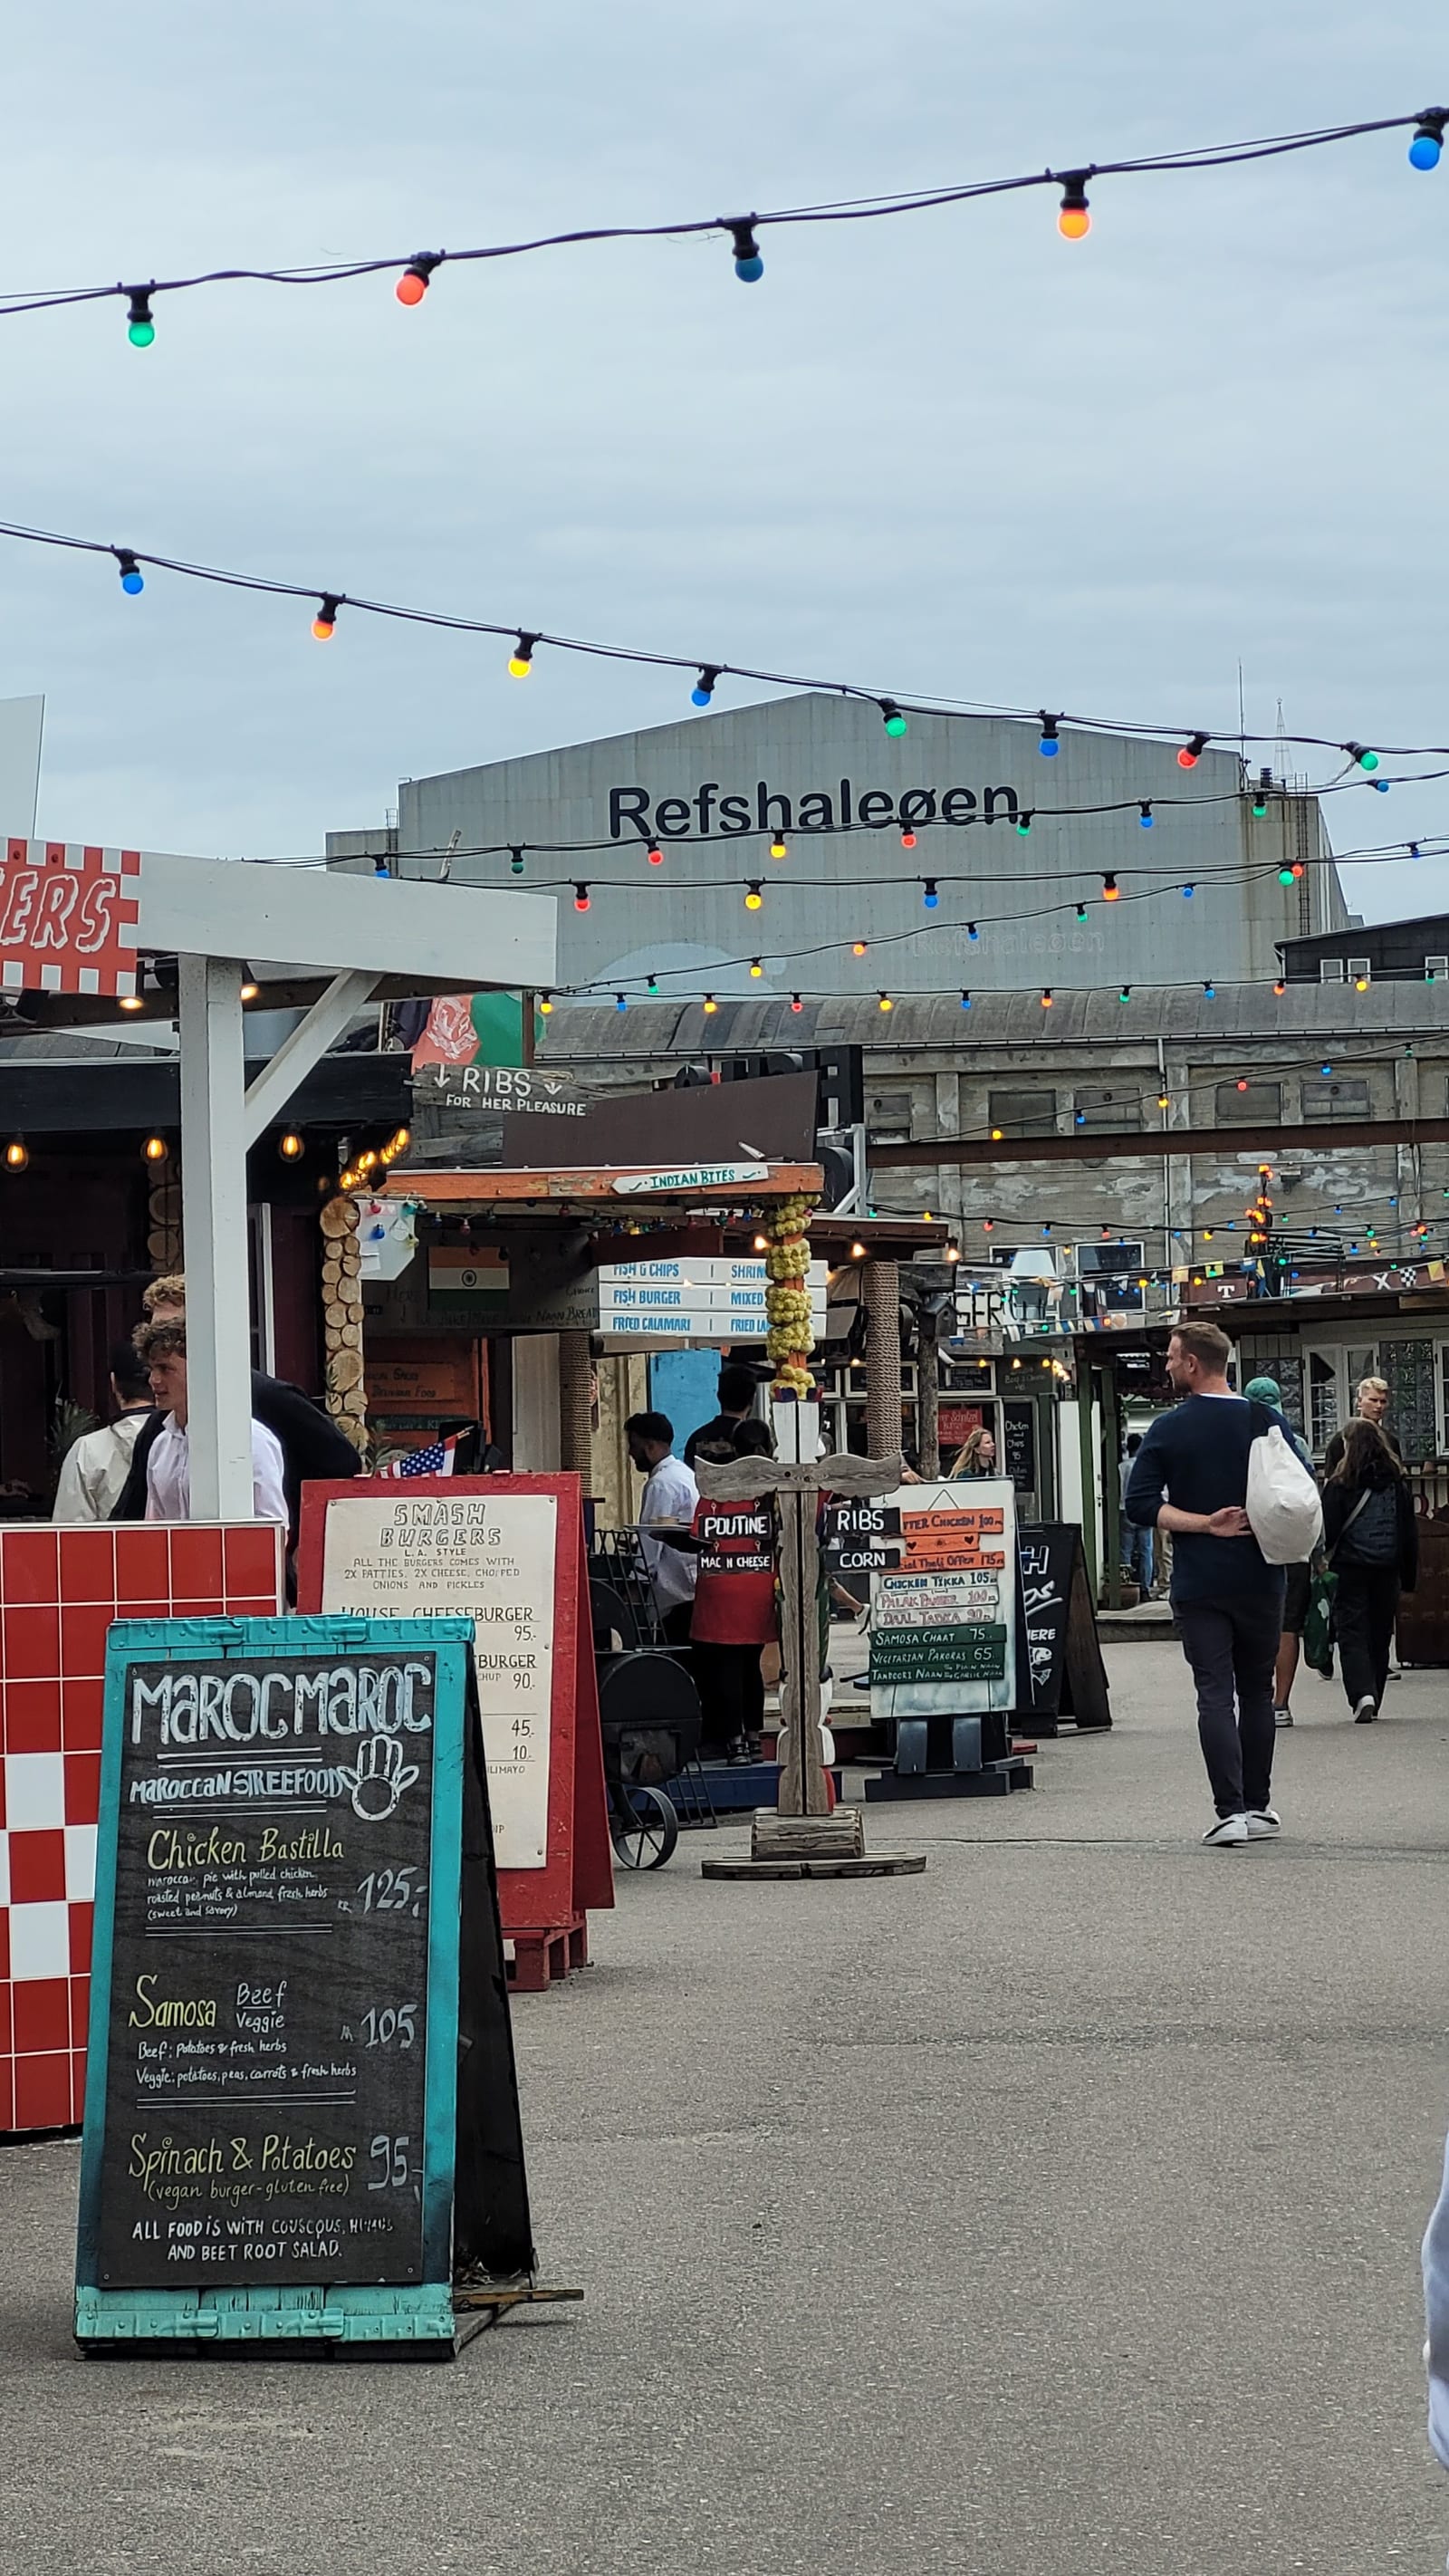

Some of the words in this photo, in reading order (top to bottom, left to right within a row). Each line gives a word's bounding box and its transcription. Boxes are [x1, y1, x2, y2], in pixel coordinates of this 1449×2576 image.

[610, 778, 1019, 839] Refshaleøen
[0, 867, 117, 953] ERS
[463, 1067, 532, 1097] RIBS
[446, 1094, 471, 1108] FOR
[483, 1098, 513, 1110] HER
[517, 1099, 586, 1116] PLEASURE
[649, 1173, 697, 1188] INDIAN
[700, 1169, 735, 1184] BITES
[648, 1263, 679, 1277] CHIPS
[613, 1290, 635, 1304] FISH
[638, 1291, 681, 1305] BURGER
[731, 1292, 763, 1305] MIXED
[612, 1316, 638, 1331] FRIED
[642, 1317, 690, 1331] CALAMARI
[731, 1319, 754, 1332] FRIED
[394, 1504, 485, 1525] SMASH
[838, 1510, 884, 1531] RIBS
[705, 1516, 767, 1537] POUTINE
[380, 1528, 501, 1547] BURGERS
[437, 1548, 466, 1556] STYLE
[700, 1556, 722, 1568] MAC
[726, 1558, 734, 1568] N
[736, 1555, 770, 1568] CHEESE
[840, 1552, 886, 1568] CORN
[353, 1558, 373, 1567] ALL
[379, 1558, 398, 1567] THE
[404, 1559, 443, 1567] BURGERS
[449, 1558, 479, 1566] COMES
[486, 1557, 514, 1565] WITH
[344, 1570, 357, 1579] 2X
[415, 1569, 427, 1578] 2X
[883, 1577, 927, 1590] CHICKEN
[931, 1574, 965, 1587] TIKKA
[970, 1572, 989, 1584] 105
[372, 1581, 408, 1590] ONIONS
[418, 1581, 438, 1589] AND
[446, 1581, 485, 1589] PICKLES
[880, 1594, 918, 1608] PALAK
[413, 1607, 533, 1621] CHEESEBURGER
[875, 1631, 919, 1646] SAMOSA
[923, 1631, 955, 1642] CHAAT
[474, 1654, 537, 1668] BURGER
[927, 1648, 966, 1661] PAKORAS
[916, 1668, 942, 1678] NAAN
[148, 1826, 246, 1870] Chicken
[256, 1828, 345, 1862] Bastilla
[202, 1872, 218, 1888] pie
[222, 1869, 247, 1880] with
[249, 1867, 276, 1886] pulled
[280, 1866, 315, 1879] chicken
[147, 1889, 179, 1904] roasted
[185, 1888, 223, 1905] peanuts
[226, 1888, 234, 1898] &
[305, 1885, 328, 1898] herbs
[148, 1908, 182, 1921] (sweet
[185, 1905, 202, 1918] and
[205, 1904, 238, 1918] savory)
[129, 1974, 216, 2028] Samosa
[236, 1980, 288, 2008] Beef
[235, 2011, 286, 2033] Veggie
[360, 2004, 417, 2049] 105
[138, 2041, 173, 2062] Beef:
[229, 2039, 254, 2057] fresh
[259, 2039, 288, 2052] herbs
[136, 2067, 176, 2090] Veggie:
[250, 2063, 287, 2080] carrots
[301, 2063, 330, 2077] fresh
[331, 2062, 357, 2077] herbs
[129, 2132, 225, 2192] Spinach
[230, 2138, 254, 2170] &
[262, 2134, 356, 2172] Potatoes
[147, 2180, 204, 2210] (vegan
[319, 2174, 350, 2196] free)
[132, 2221, 161, 2241] ALL
[168, 2222, 202, 2238] FOOD
[168, 2244, 196, 2262] AND
[201, 2244, 239, 2262] BEET
[244, 2241, 288, 2259] ROOT
